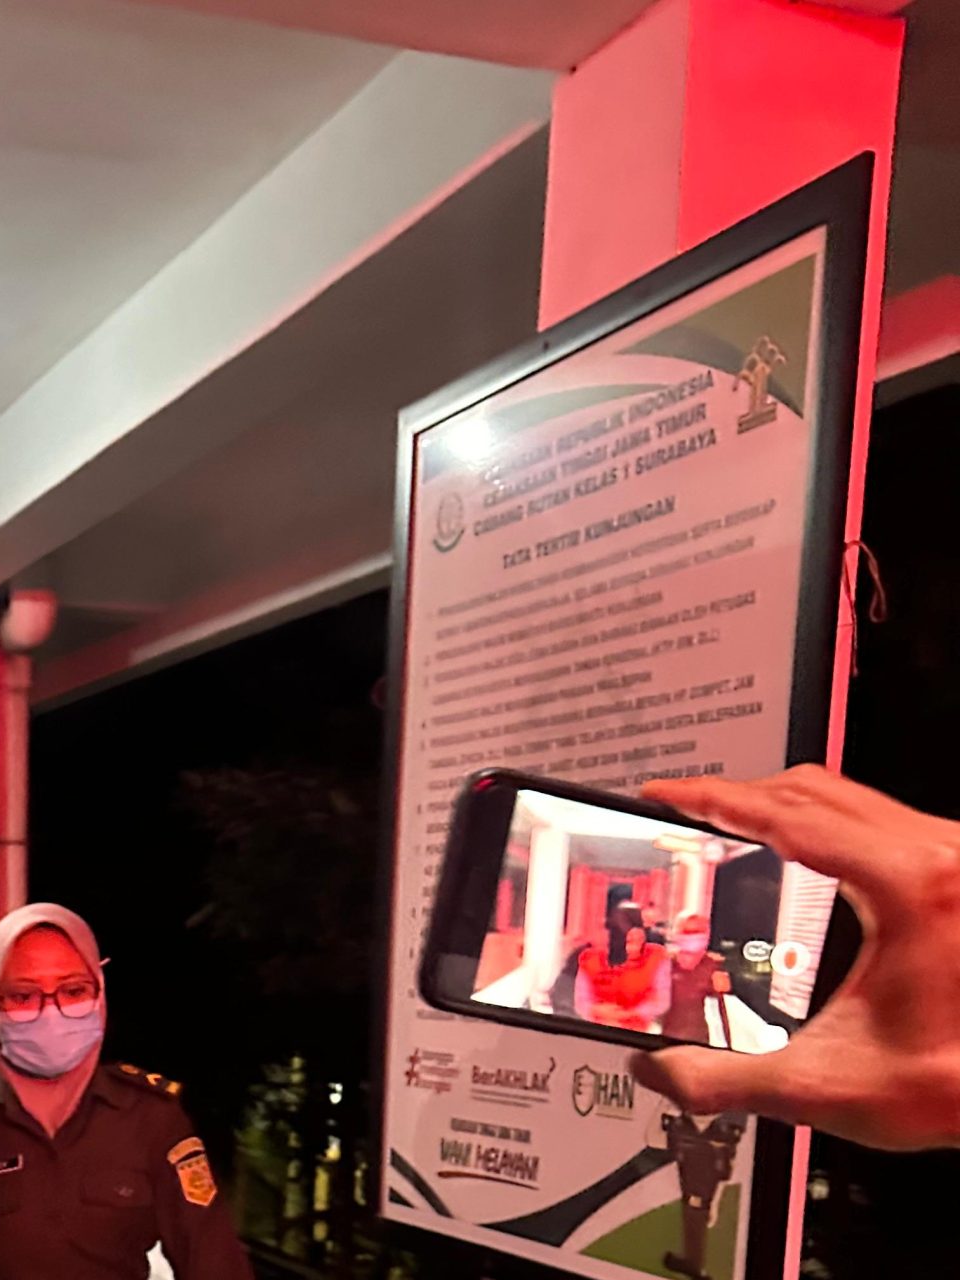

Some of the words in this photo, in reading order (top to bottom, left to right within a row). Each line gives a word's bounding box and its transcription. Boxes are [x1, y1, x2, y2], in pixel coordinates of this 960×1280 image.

[628, 369, 715, 423] INDONESIA
[611, 427, 651, 458] JAWA
[655, 402, 707, 439] TIMUR
[573, 467, 618, 498] KELAS
[634, 428, 717, 475] SURABAYA
[502, 546, 532, 570] TATA
[584, 495, 677, 542] KUNJUNGAN
[471, 1064, 551, 1093] BerAKHLAK
